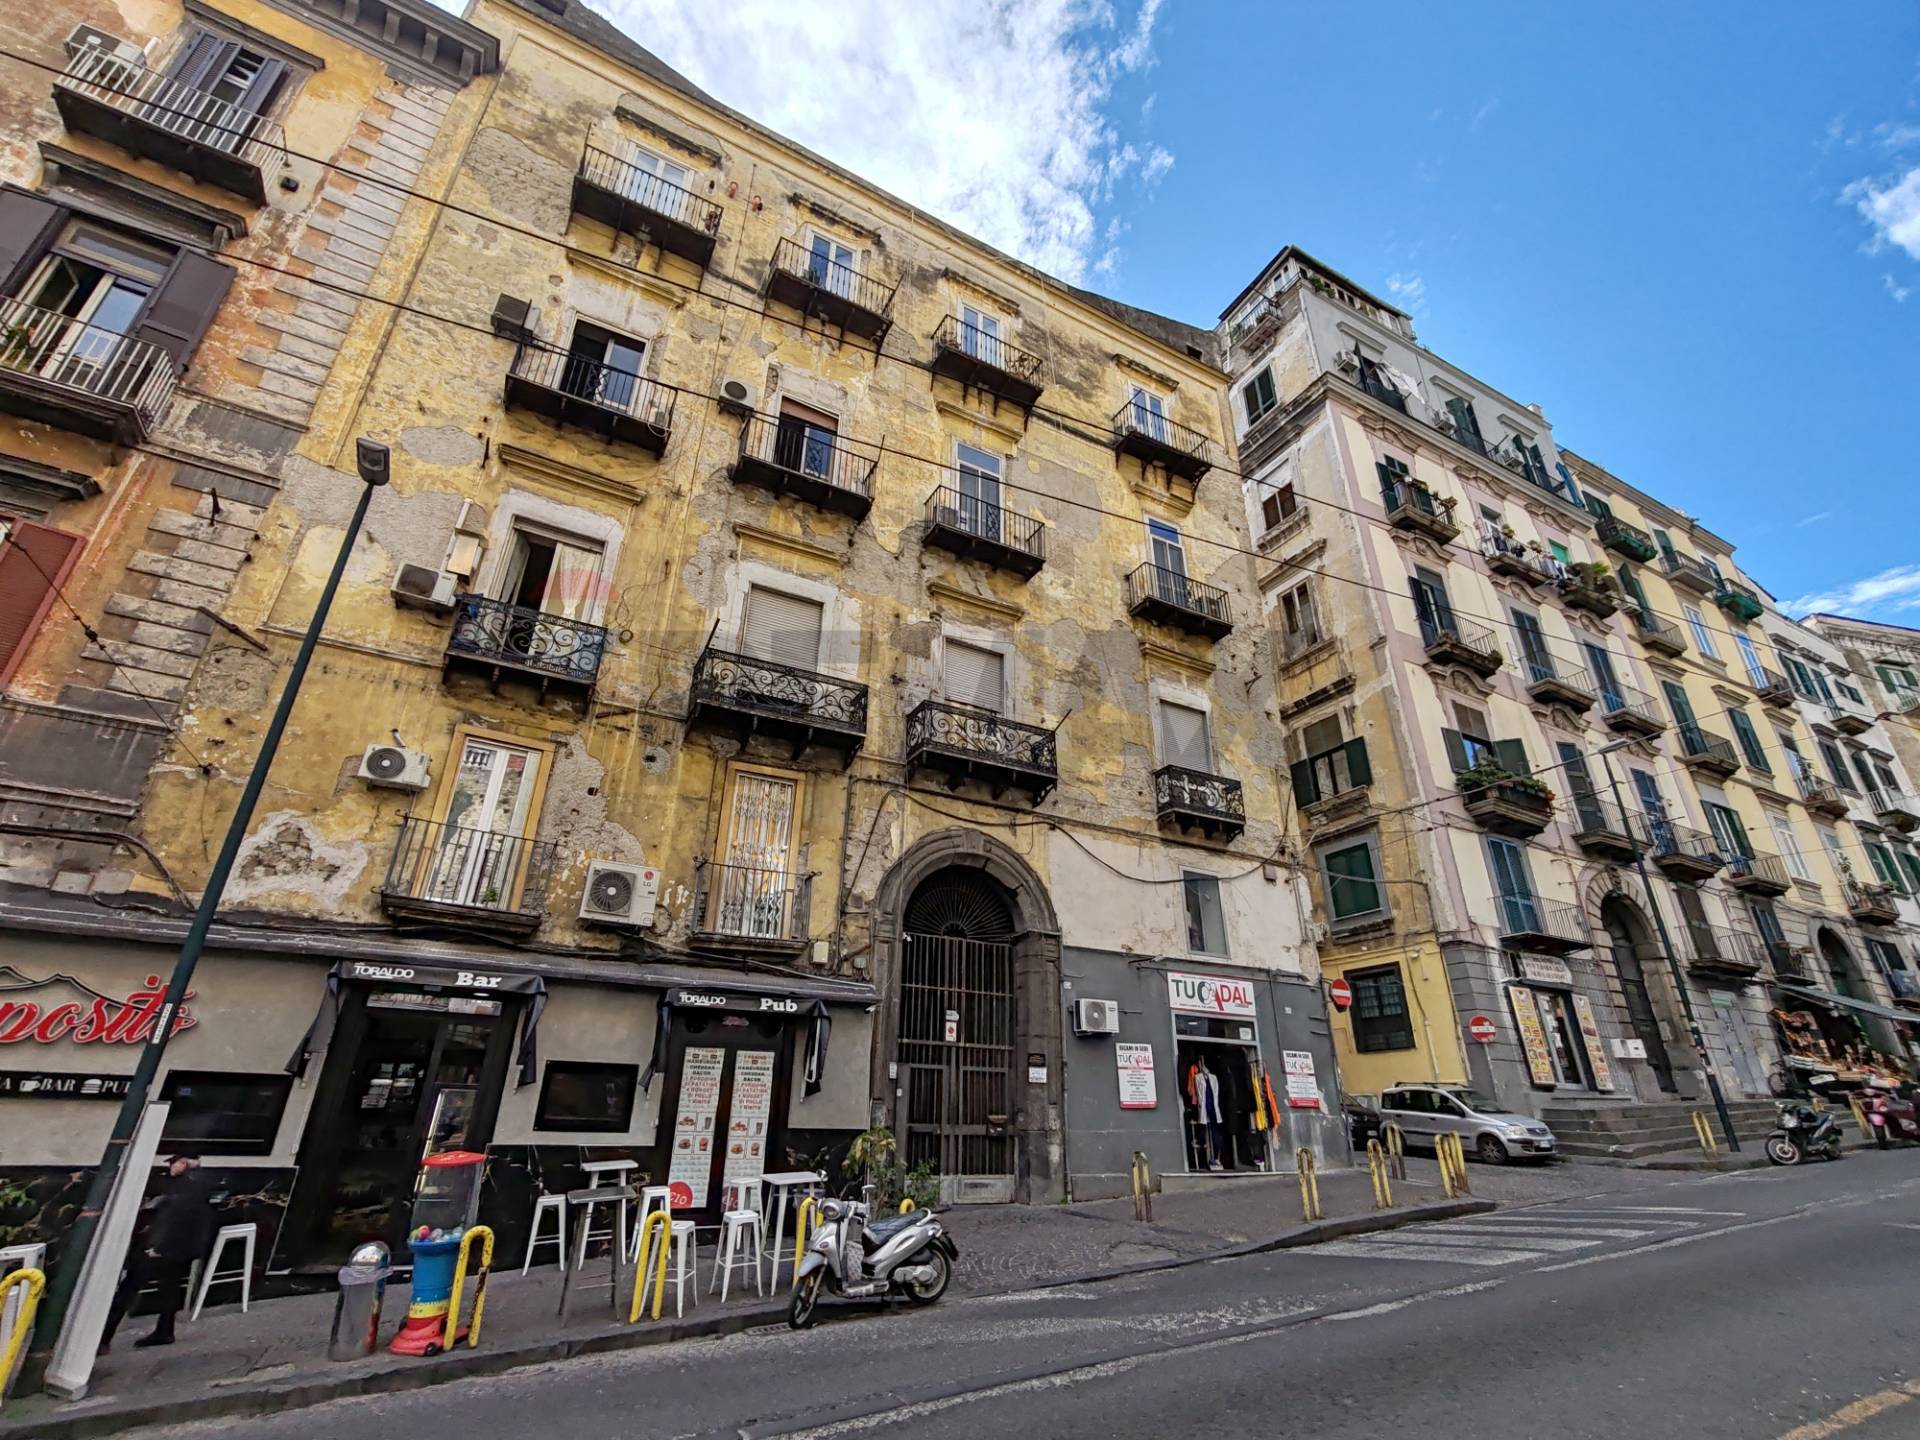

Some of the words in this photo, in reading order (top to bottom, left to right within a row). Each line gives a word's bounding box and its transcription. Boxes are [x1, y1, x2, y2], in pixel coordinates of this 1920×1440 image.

[353, 965, 415, 979] TORALDO
[455, 972, 503, 988] Bar
[679, 993, 727, 1006] TORALDO
[759, 997, 798, 1012] Pub
[39, 1078, 76, 1092] BAR
